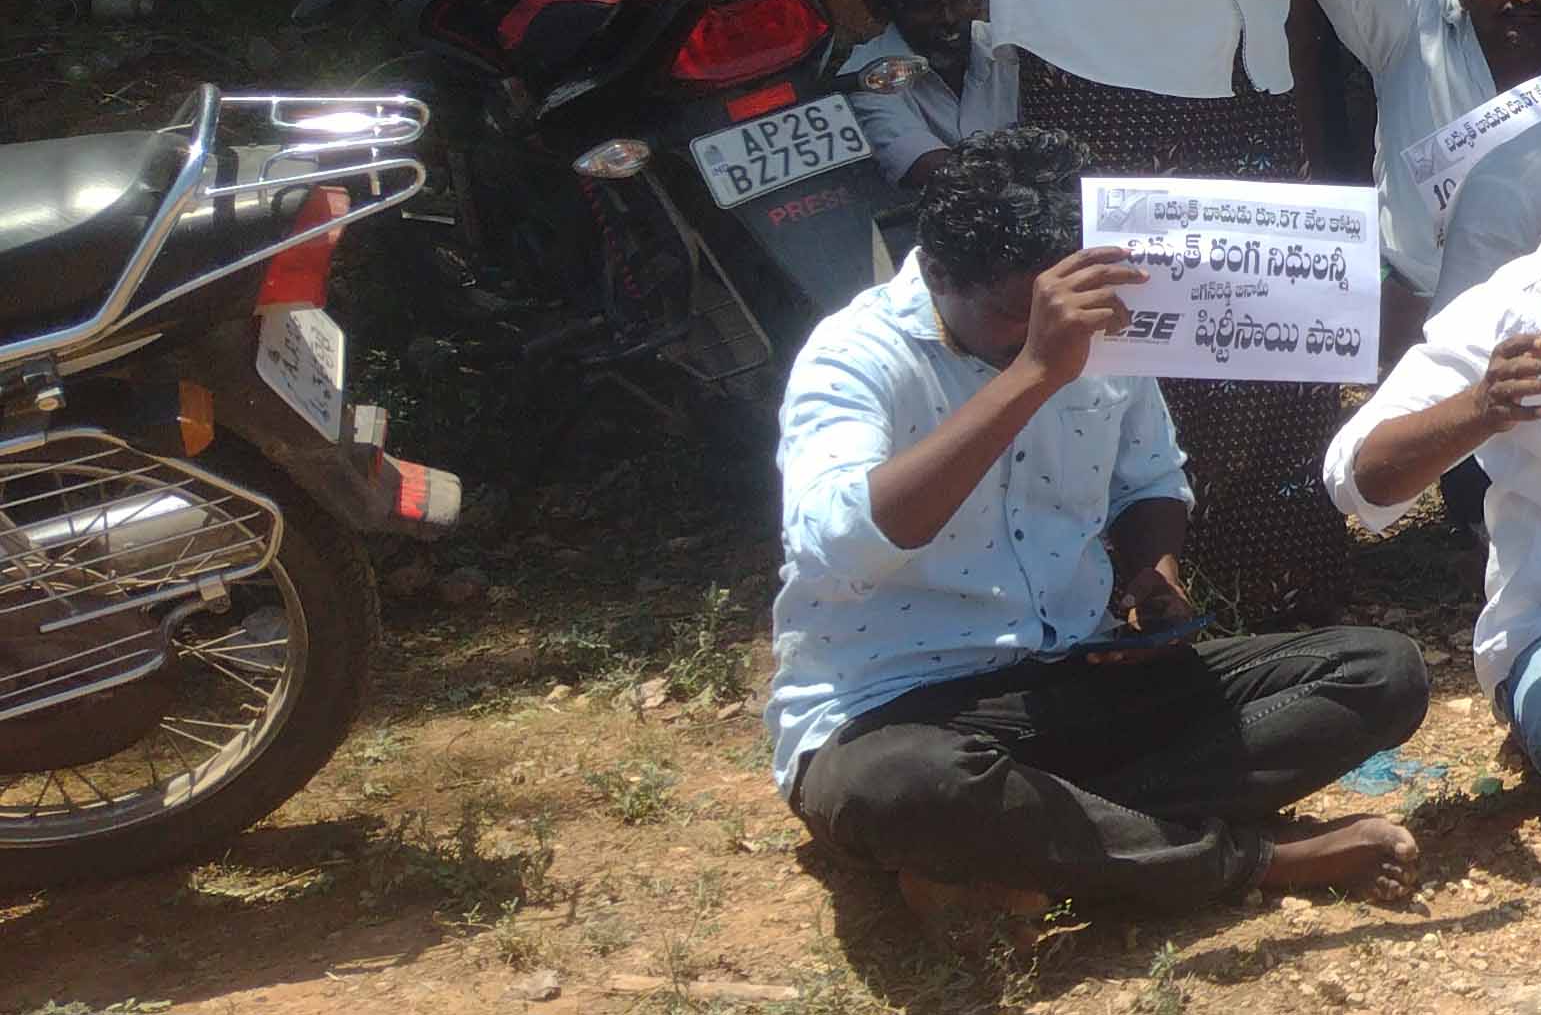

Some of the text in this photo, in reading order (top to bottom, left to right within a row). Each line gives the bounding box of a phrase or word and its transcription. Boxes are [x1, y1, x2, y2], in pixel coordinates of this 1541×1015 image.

[741, 105, 829, 157] AP26
[727, 125, 863, 195] BZ7579
[1153, 199, 1199, 229] విద్యుత్
[1255, 209, 1300, 231] రూ.57
[1127, 233, 1202, 282] విద్యుత్
[1209, 238, 1261, 275] రంగ
[1306, 318, 1361, 357] పాలు
